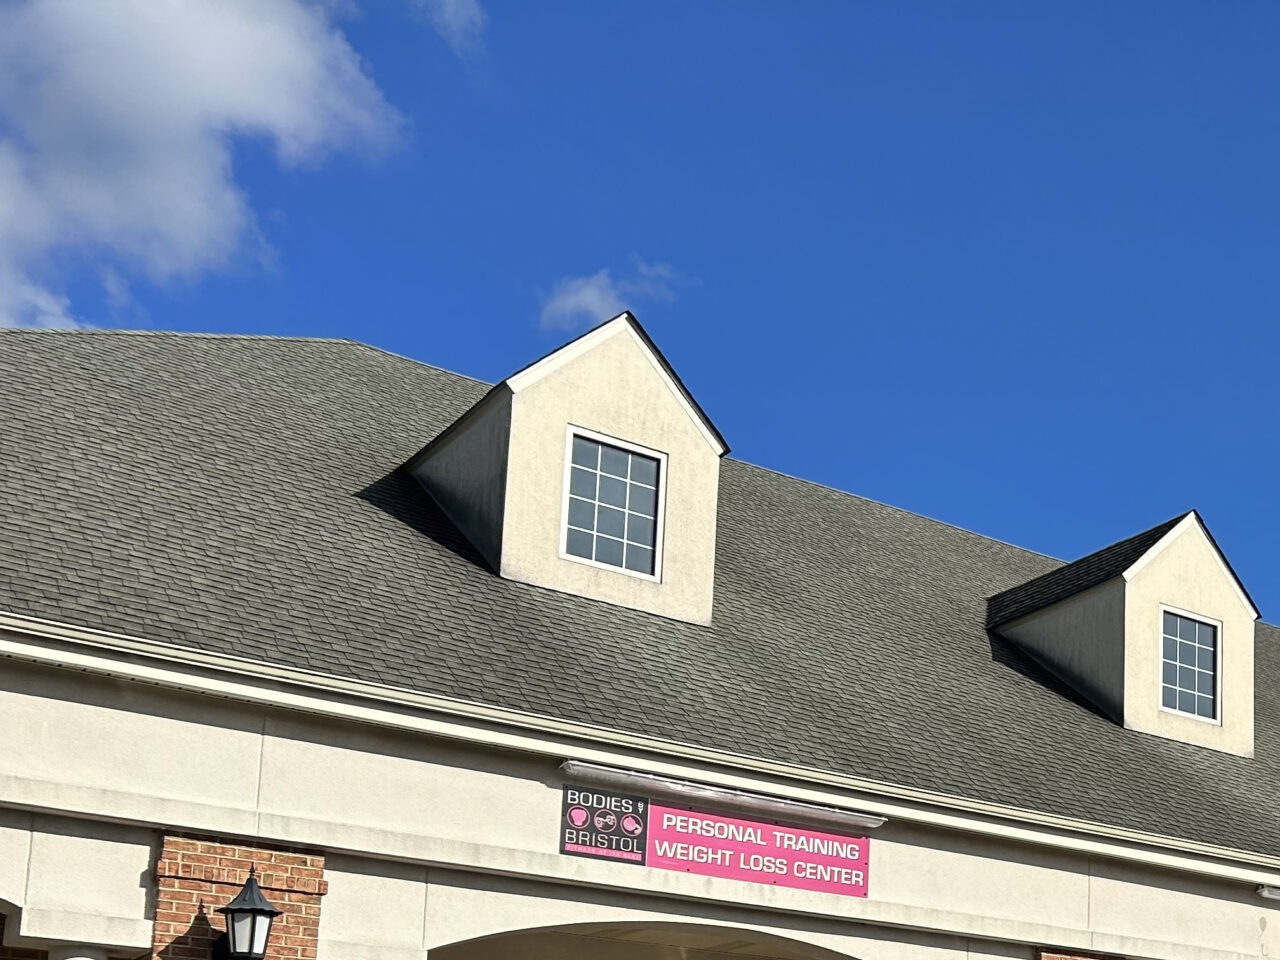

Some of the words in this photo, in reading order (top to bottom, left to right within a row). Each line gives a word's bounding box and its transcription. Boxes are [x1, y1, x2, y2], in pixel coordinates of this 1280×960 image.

[567, 790, 633, 812] BODIES
[565, 829, 643, 853] BRISTOL
[662, 813, 767, 846] PERSONAL
[773, 831, 860, 860] TRAINING
[655, 839, 733, 867] WEIGHT
[739, 853, 790, 876] LOSS
[793, 861, 864, 887] CENTER
